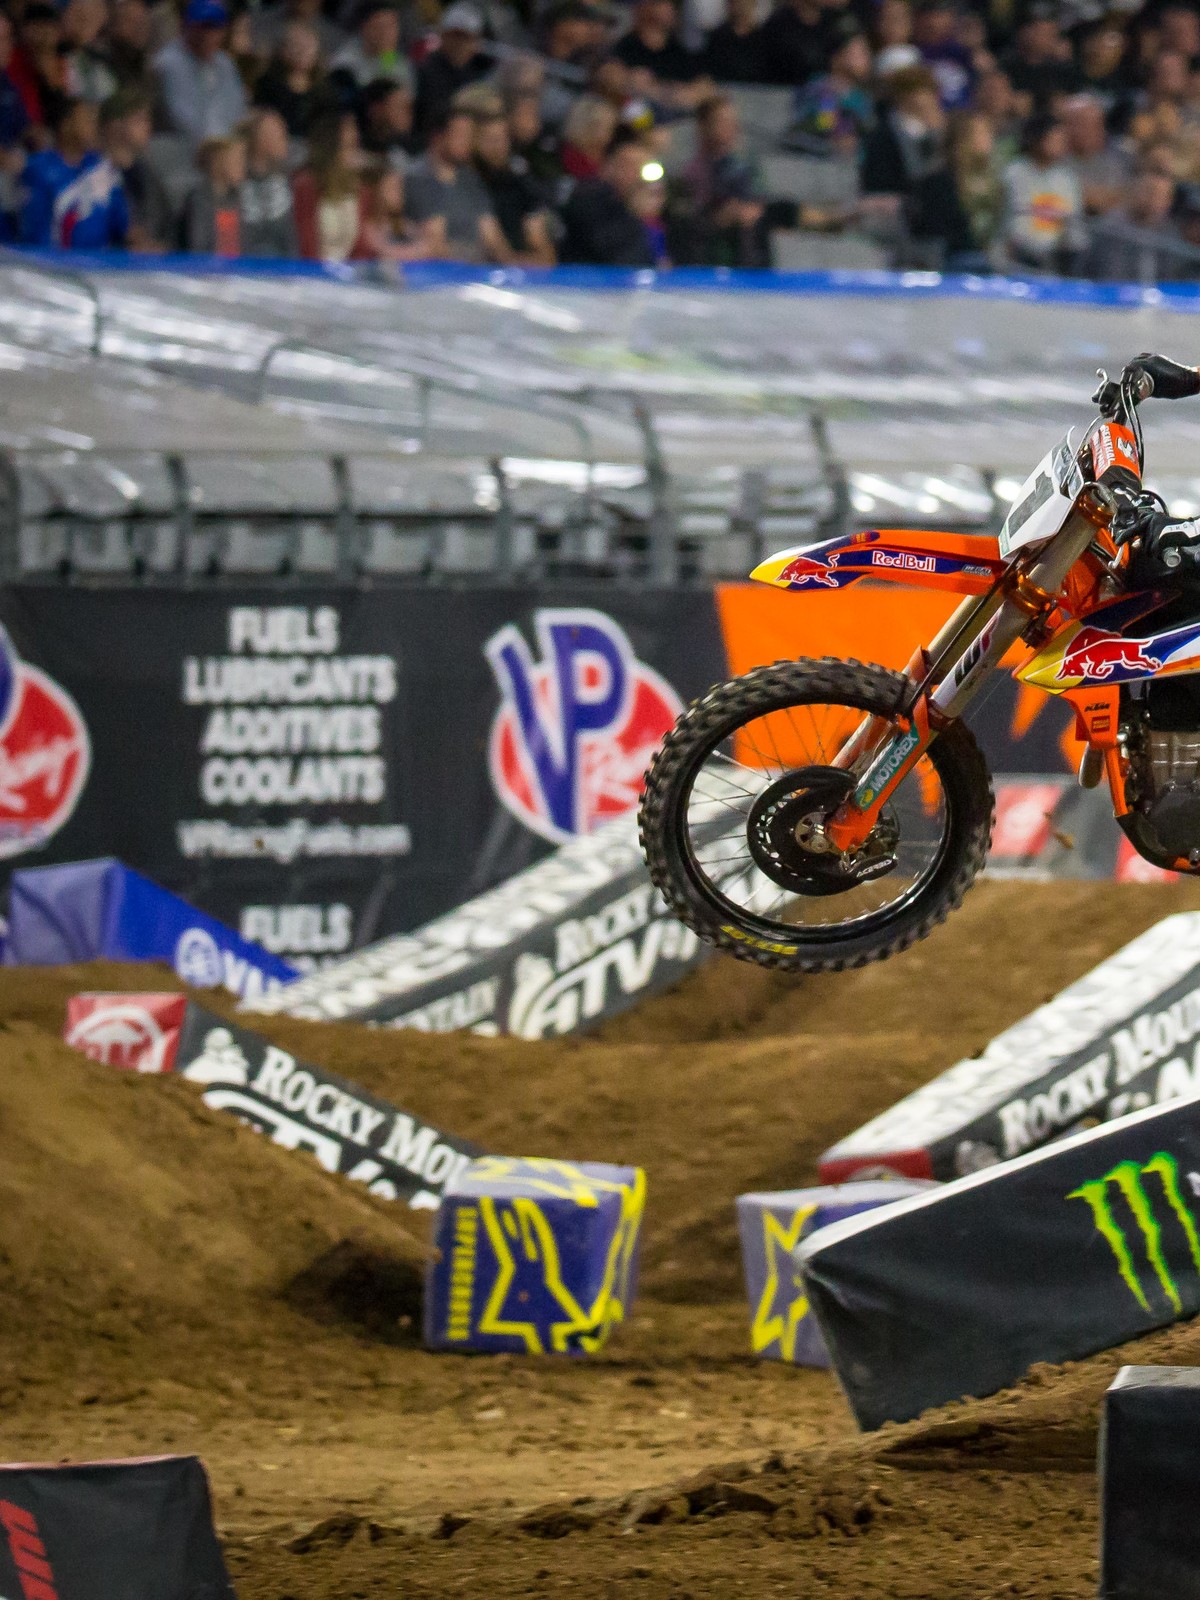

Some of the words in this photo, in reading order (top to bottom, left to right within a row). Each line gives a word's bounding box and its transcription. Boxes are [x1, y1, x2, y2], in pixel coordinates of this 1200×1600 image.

[872, 551, 904, 567] Red
[904, 555, 937, 572] Bull
[228, 606, 340, 653] FUELS
[183, 655, 397, 704] LUBRICANTS
[202, 706, 382, 753] ADDITIVES
[202, 756, 386, 804] COOLANTS
[869, 733, 919, 792] MOTOREX
[240, 903, 351, 954] FUELS
[251, 1045, 387, 1147] ROCKY
[999, 1054, 1112, 1157] ROCKY
